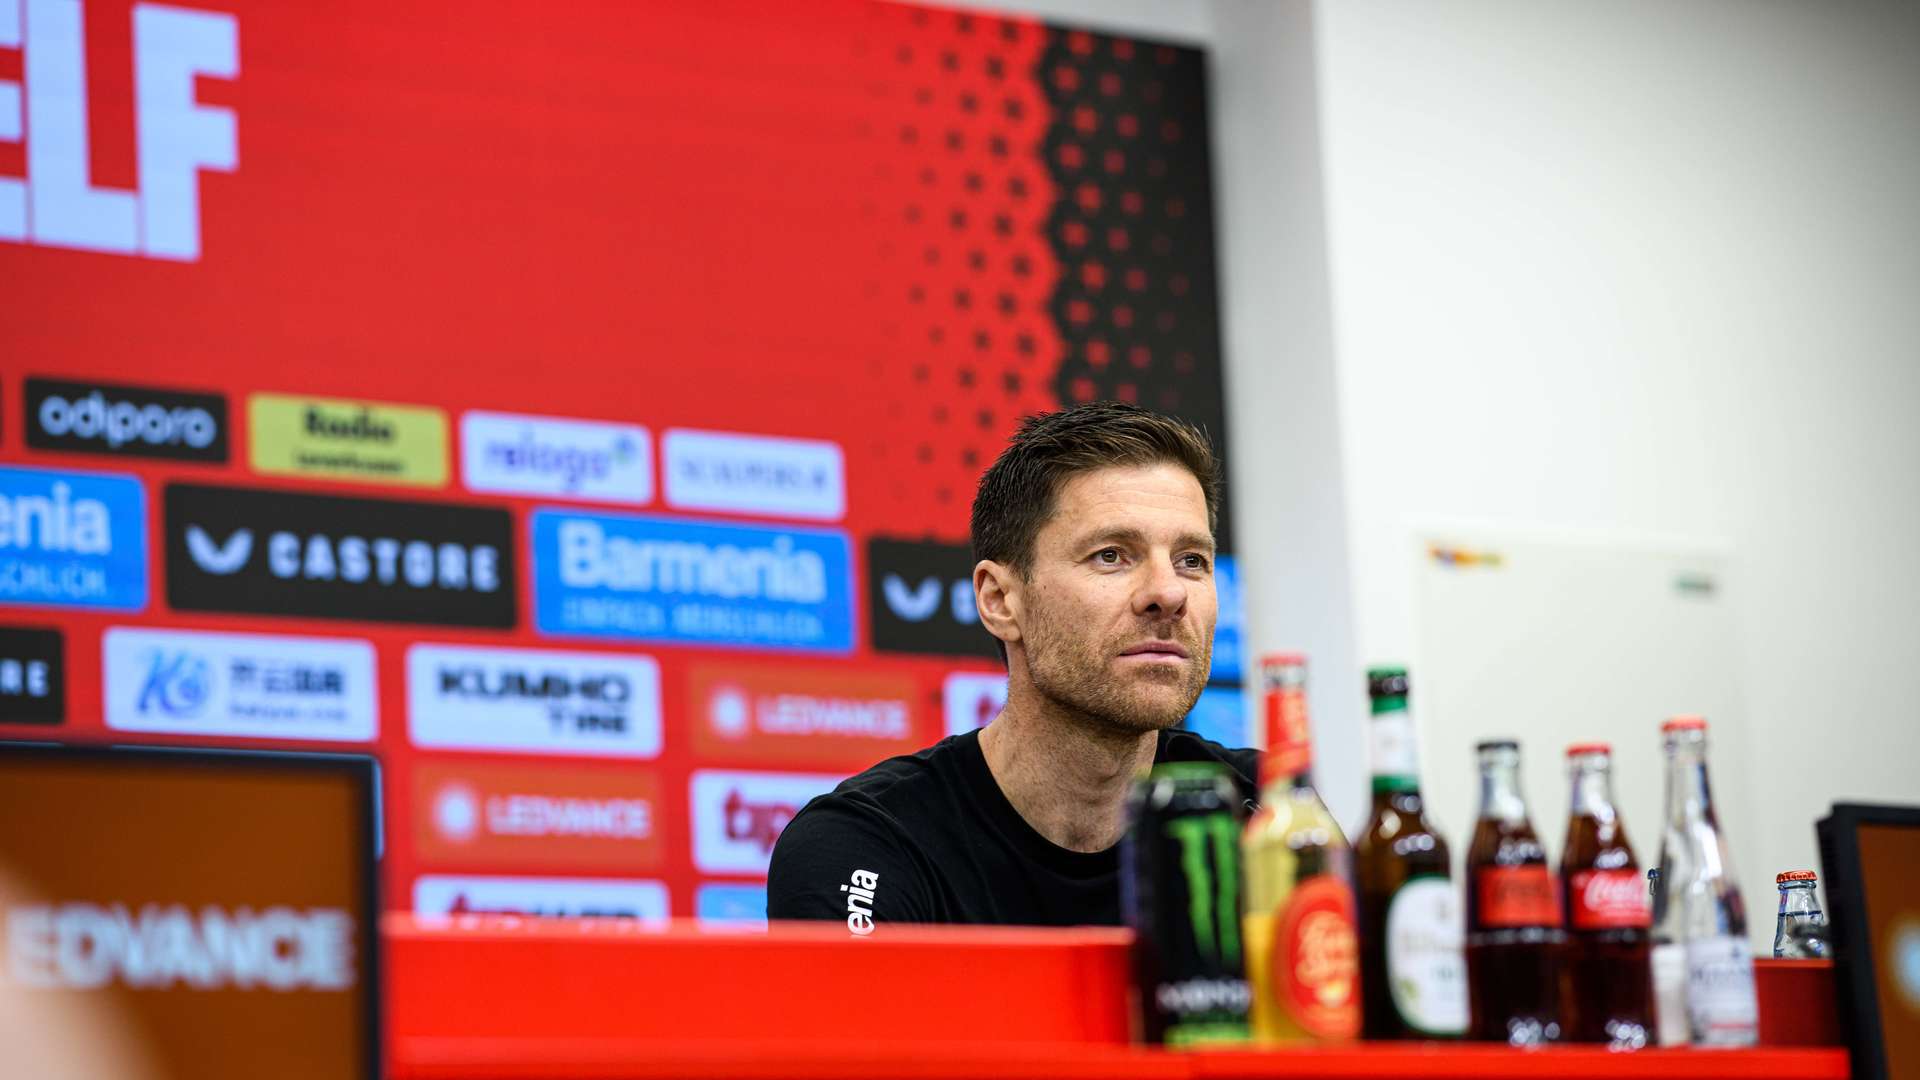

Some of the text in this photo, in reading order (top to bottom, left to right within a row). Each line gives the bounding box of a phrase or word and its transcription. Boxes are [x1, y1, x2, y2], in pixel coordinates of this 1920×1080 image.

[0, 0, 241, 262] LF
[267, 530, 498, 593] CASTORE
[557, 518, 827, 603] Barmenia
[438, 665, 632, 705] KUMHO
[757, 693, 911, 740] LEDVANCE
[486, 794, 652, 840] LEDVANCE
[840, 869, 880, 936] enia
